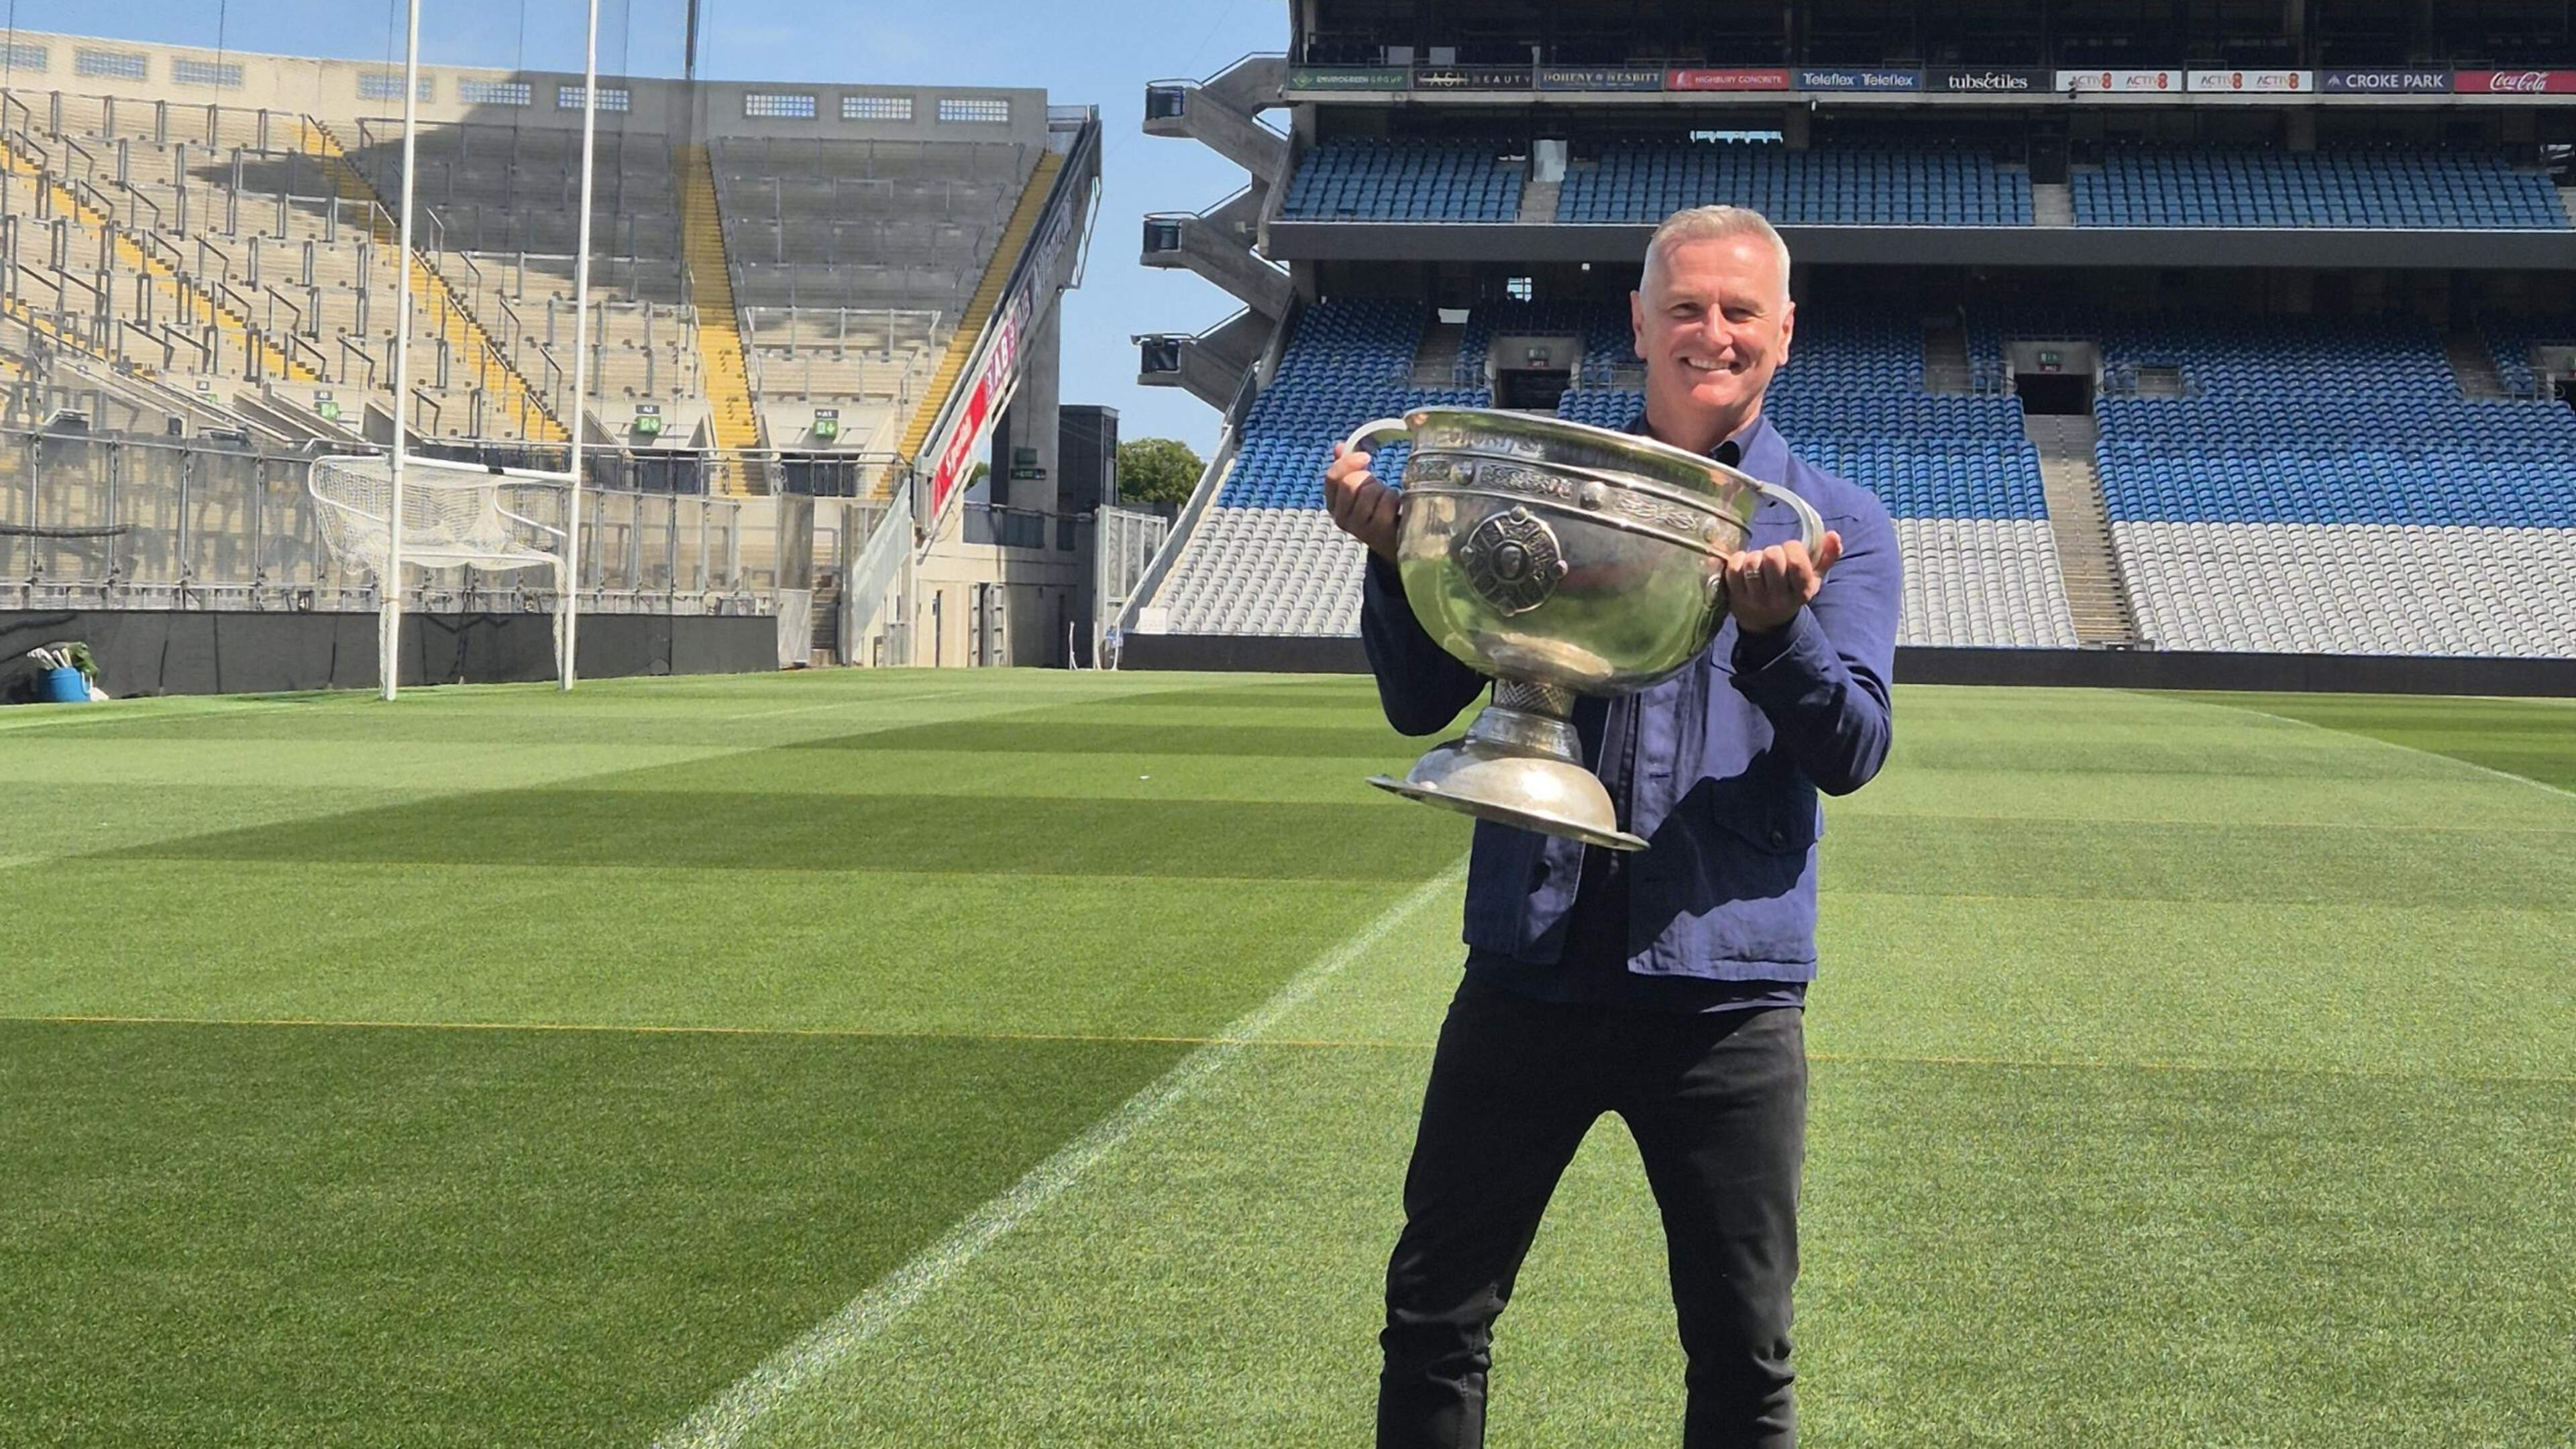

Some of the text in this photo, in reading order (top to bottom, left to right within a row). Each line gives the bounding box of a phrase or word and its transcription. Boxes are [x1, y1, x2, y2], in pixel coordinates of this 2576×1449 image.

[1472, 75, 1531, 83] BEAUTY
[1544, 72, 1659, 82] DOHENY & NESBITT
[1803, 73, 1913, 86] Teleflex Teleflex
[1949, 72, 2029, 89] tubs&tiles
[2346, 74, 2444, 87] CROKE PARK
